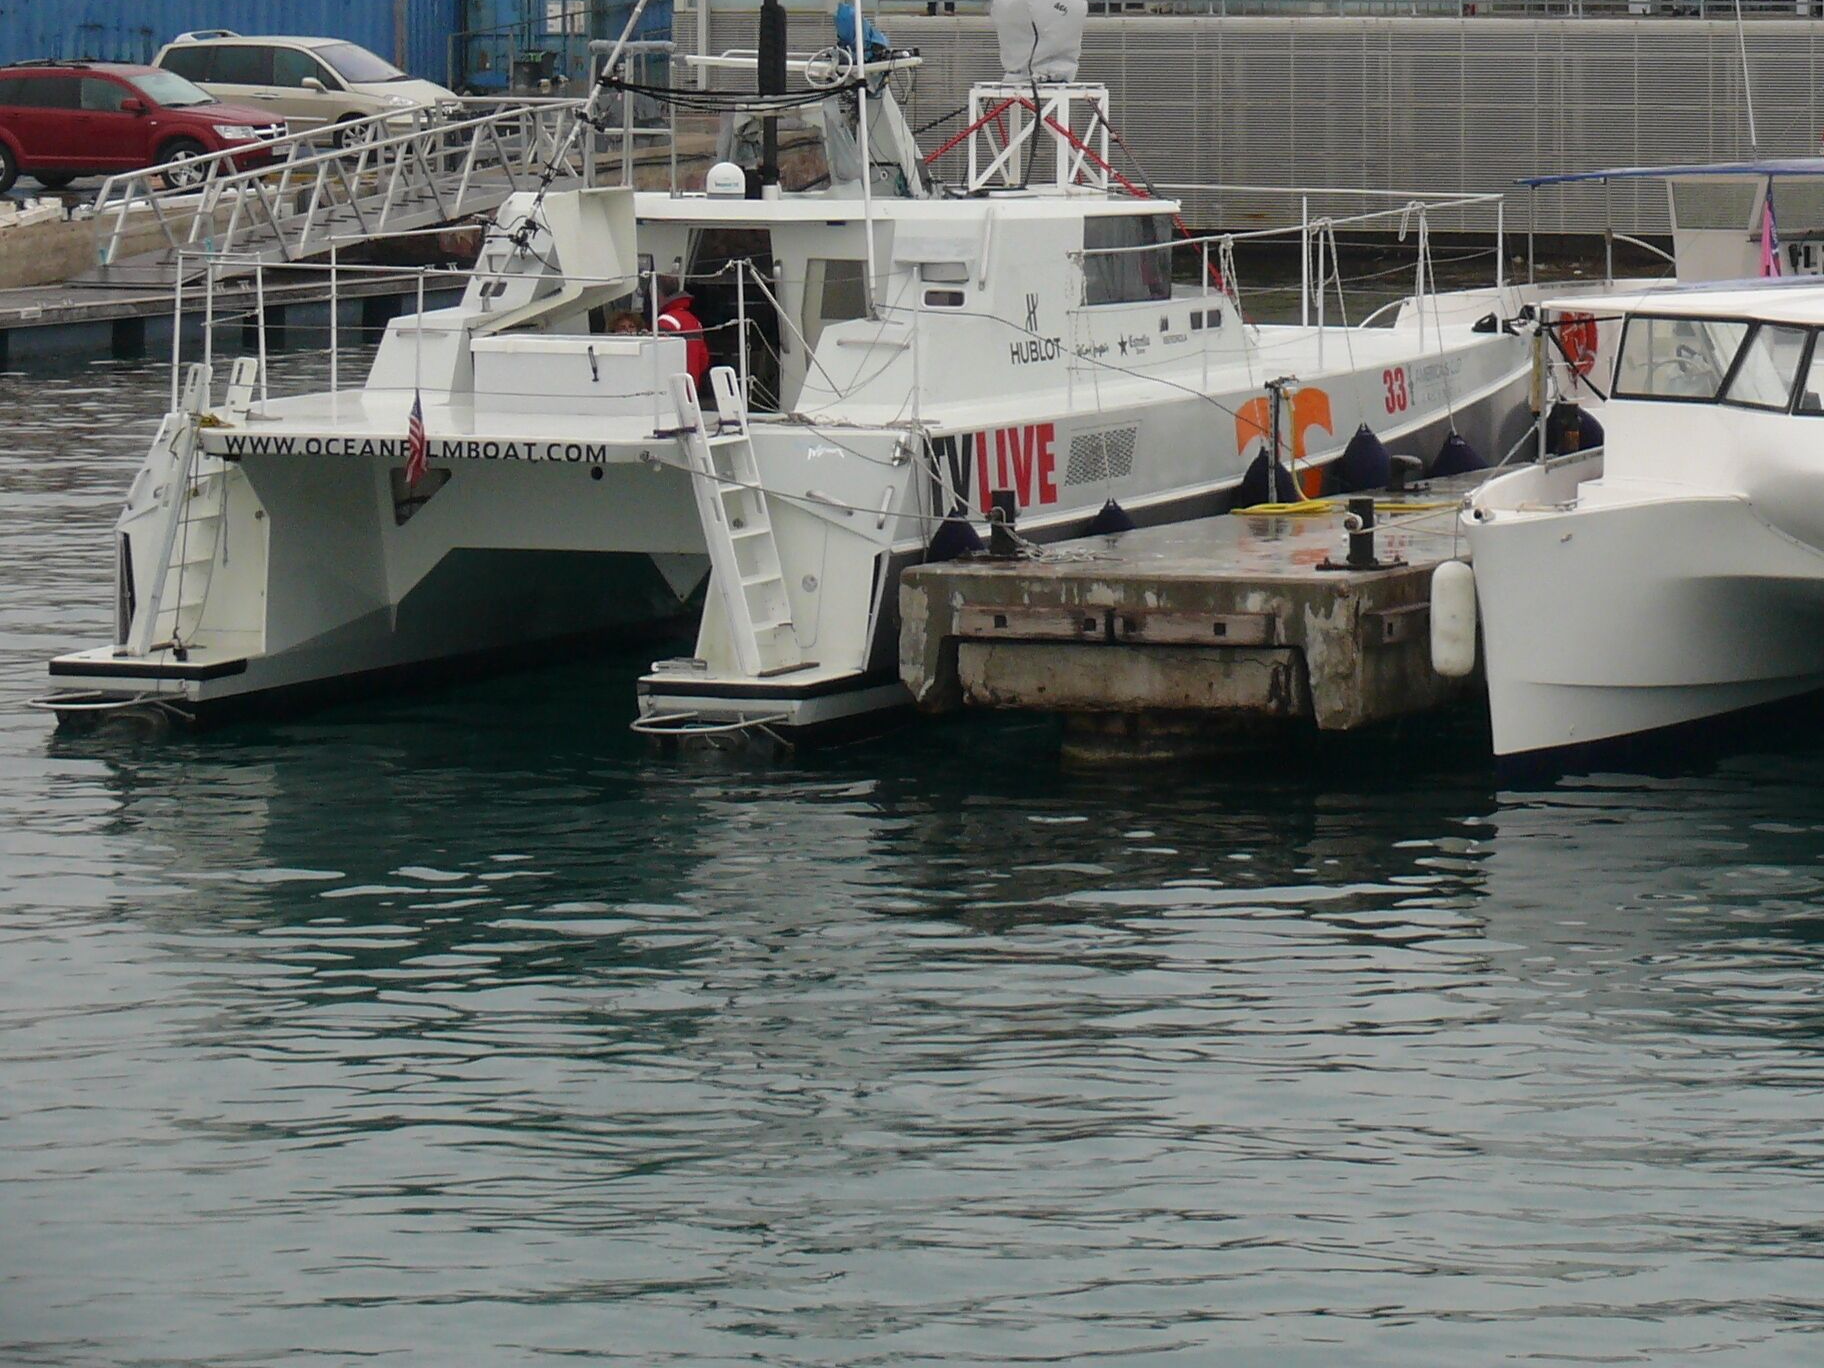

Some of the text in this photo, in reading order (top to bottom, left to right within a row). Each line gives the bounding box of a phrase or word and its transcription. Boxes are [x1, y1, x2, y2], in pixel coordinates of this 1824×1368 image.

[1010, 338, 1061, 365] HUBLOT
[1383, 367, 1408, 414] 33
[225, 435, 607, 464] WWW.OCEANFLMBOAT.COM
